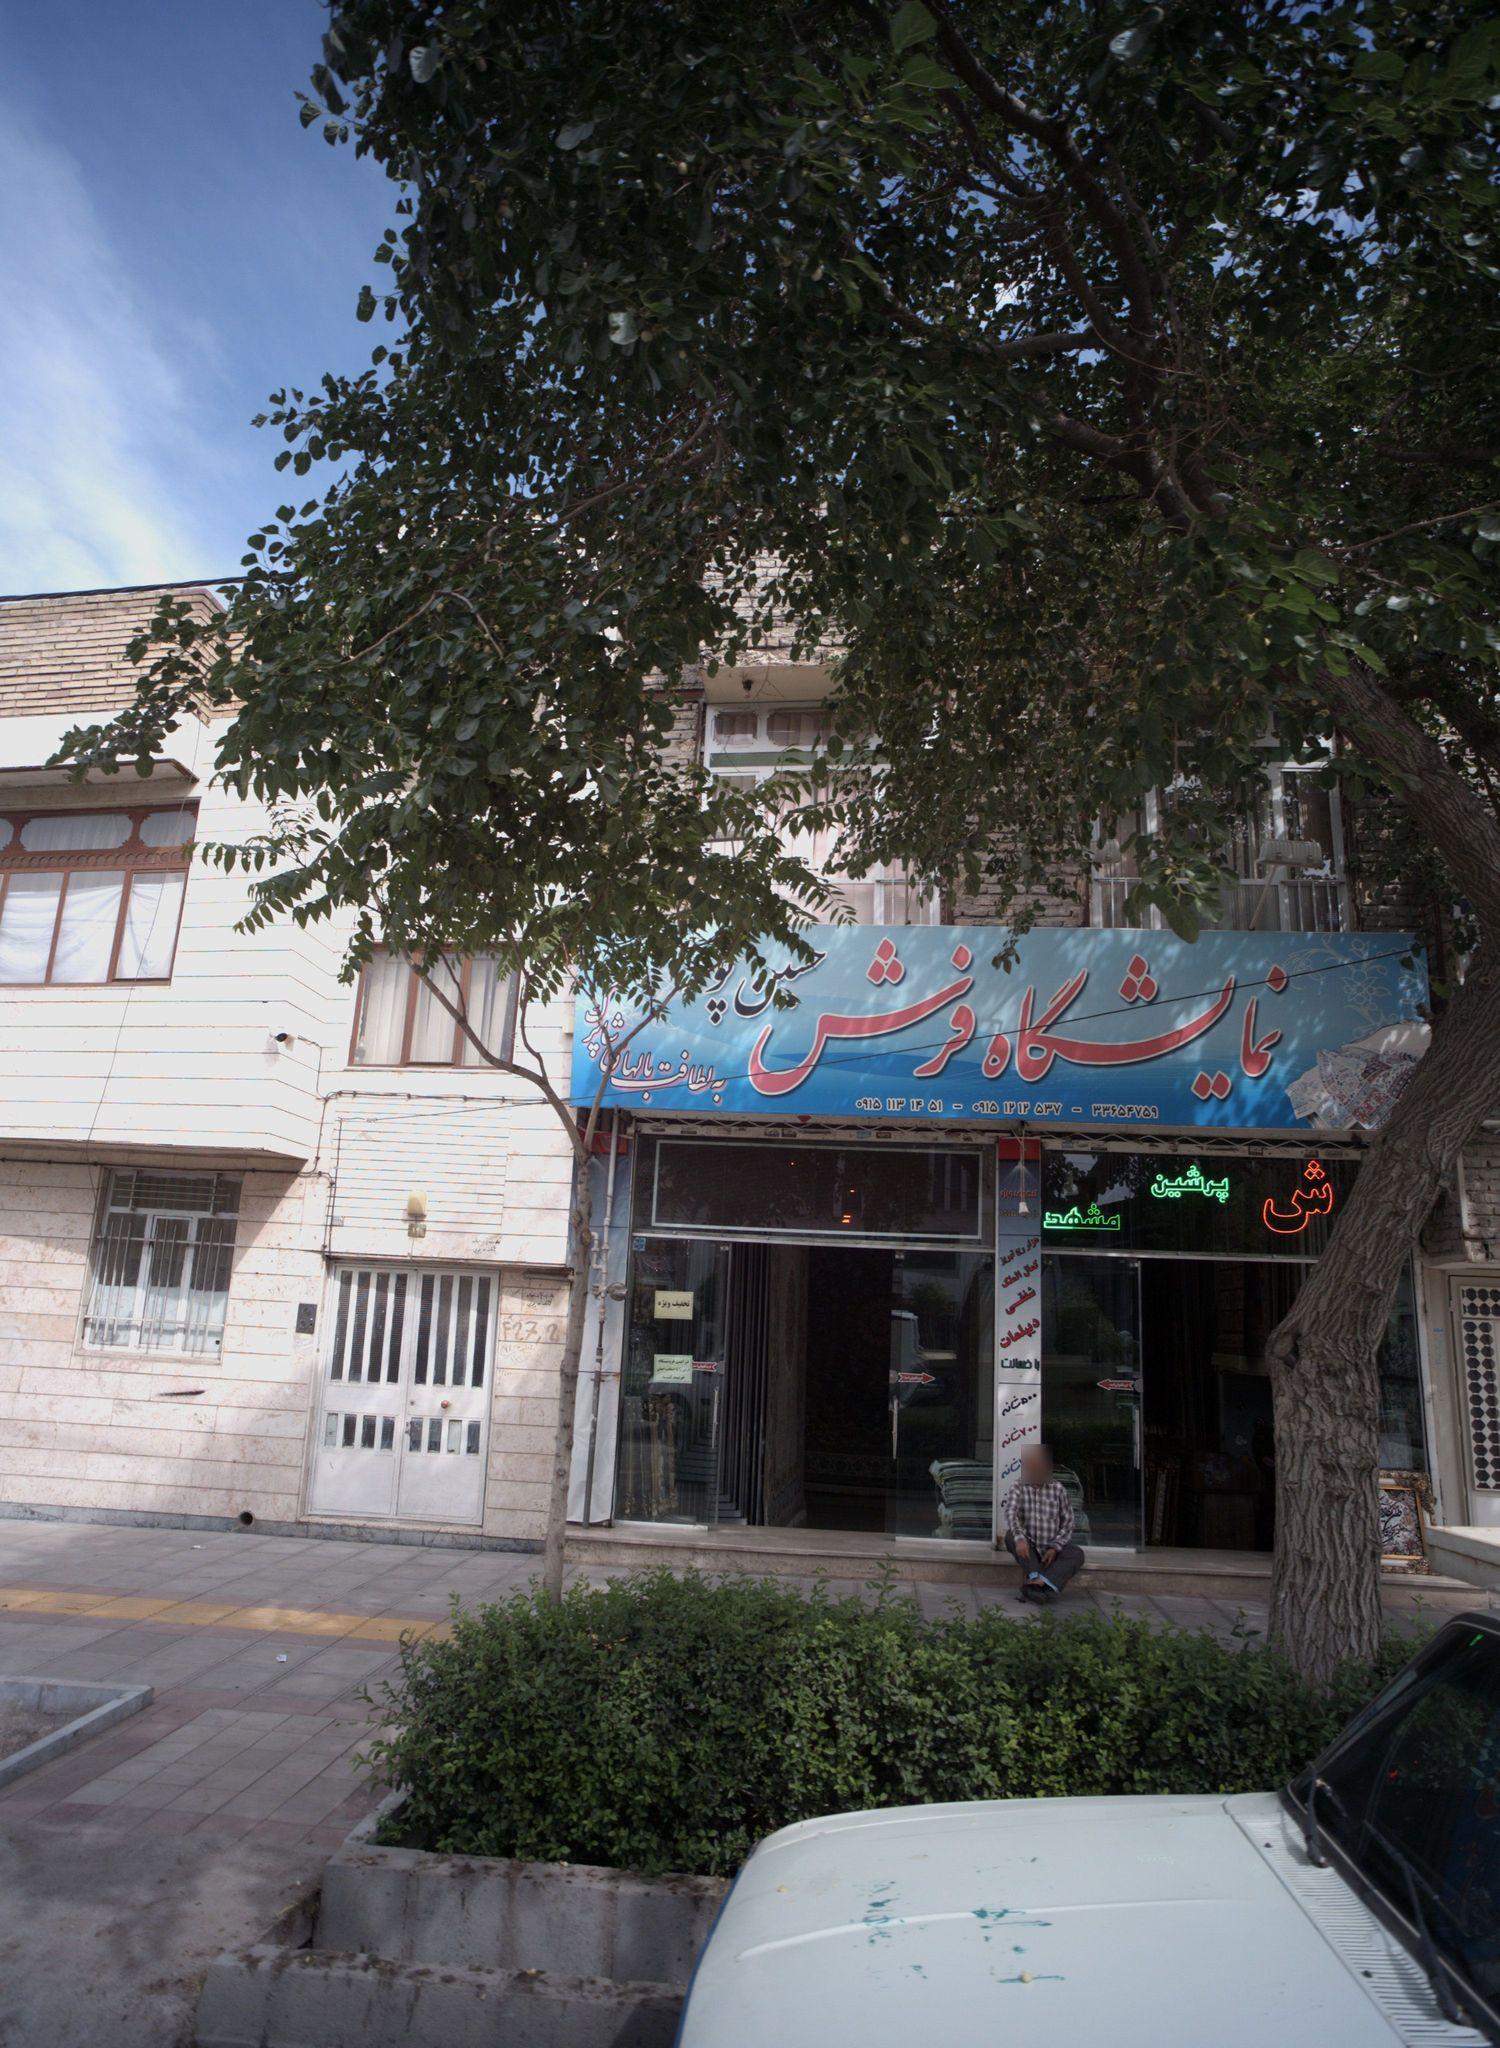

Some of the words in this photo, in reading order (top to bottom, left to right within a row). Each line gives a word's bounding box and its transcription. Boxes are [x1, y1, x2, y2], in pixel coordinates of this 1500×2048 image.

[747, 936, 977, 1097] فرش
[981, 953, 1289, 1101] نمایشگاه
[855, 1097, 883, 1111] ۰۹۱۵
[886, 1097, 906, 1111] ۱۱۳
[910, 1098, 925, 1112] ۱۴
[927, 1098, 943, 1113] ۵۱
[972, 1100, 999, 1114] ۰۹۱۵
[1034, 1102, 1063, 1116] ۵۳۷
[1091, 1103, 1159, 1119] ۳۳۶۵۴۷۵۹
[1150, 1165, 1229, 1204] پرشین
[1043, 1203, 1121, 1231] مشهد
[658, 1299, 671, 1309] ویژه
[672, 1299, 690, 1309] تخفیف
[999, 1318, 1040, 1349] دیپلمات
